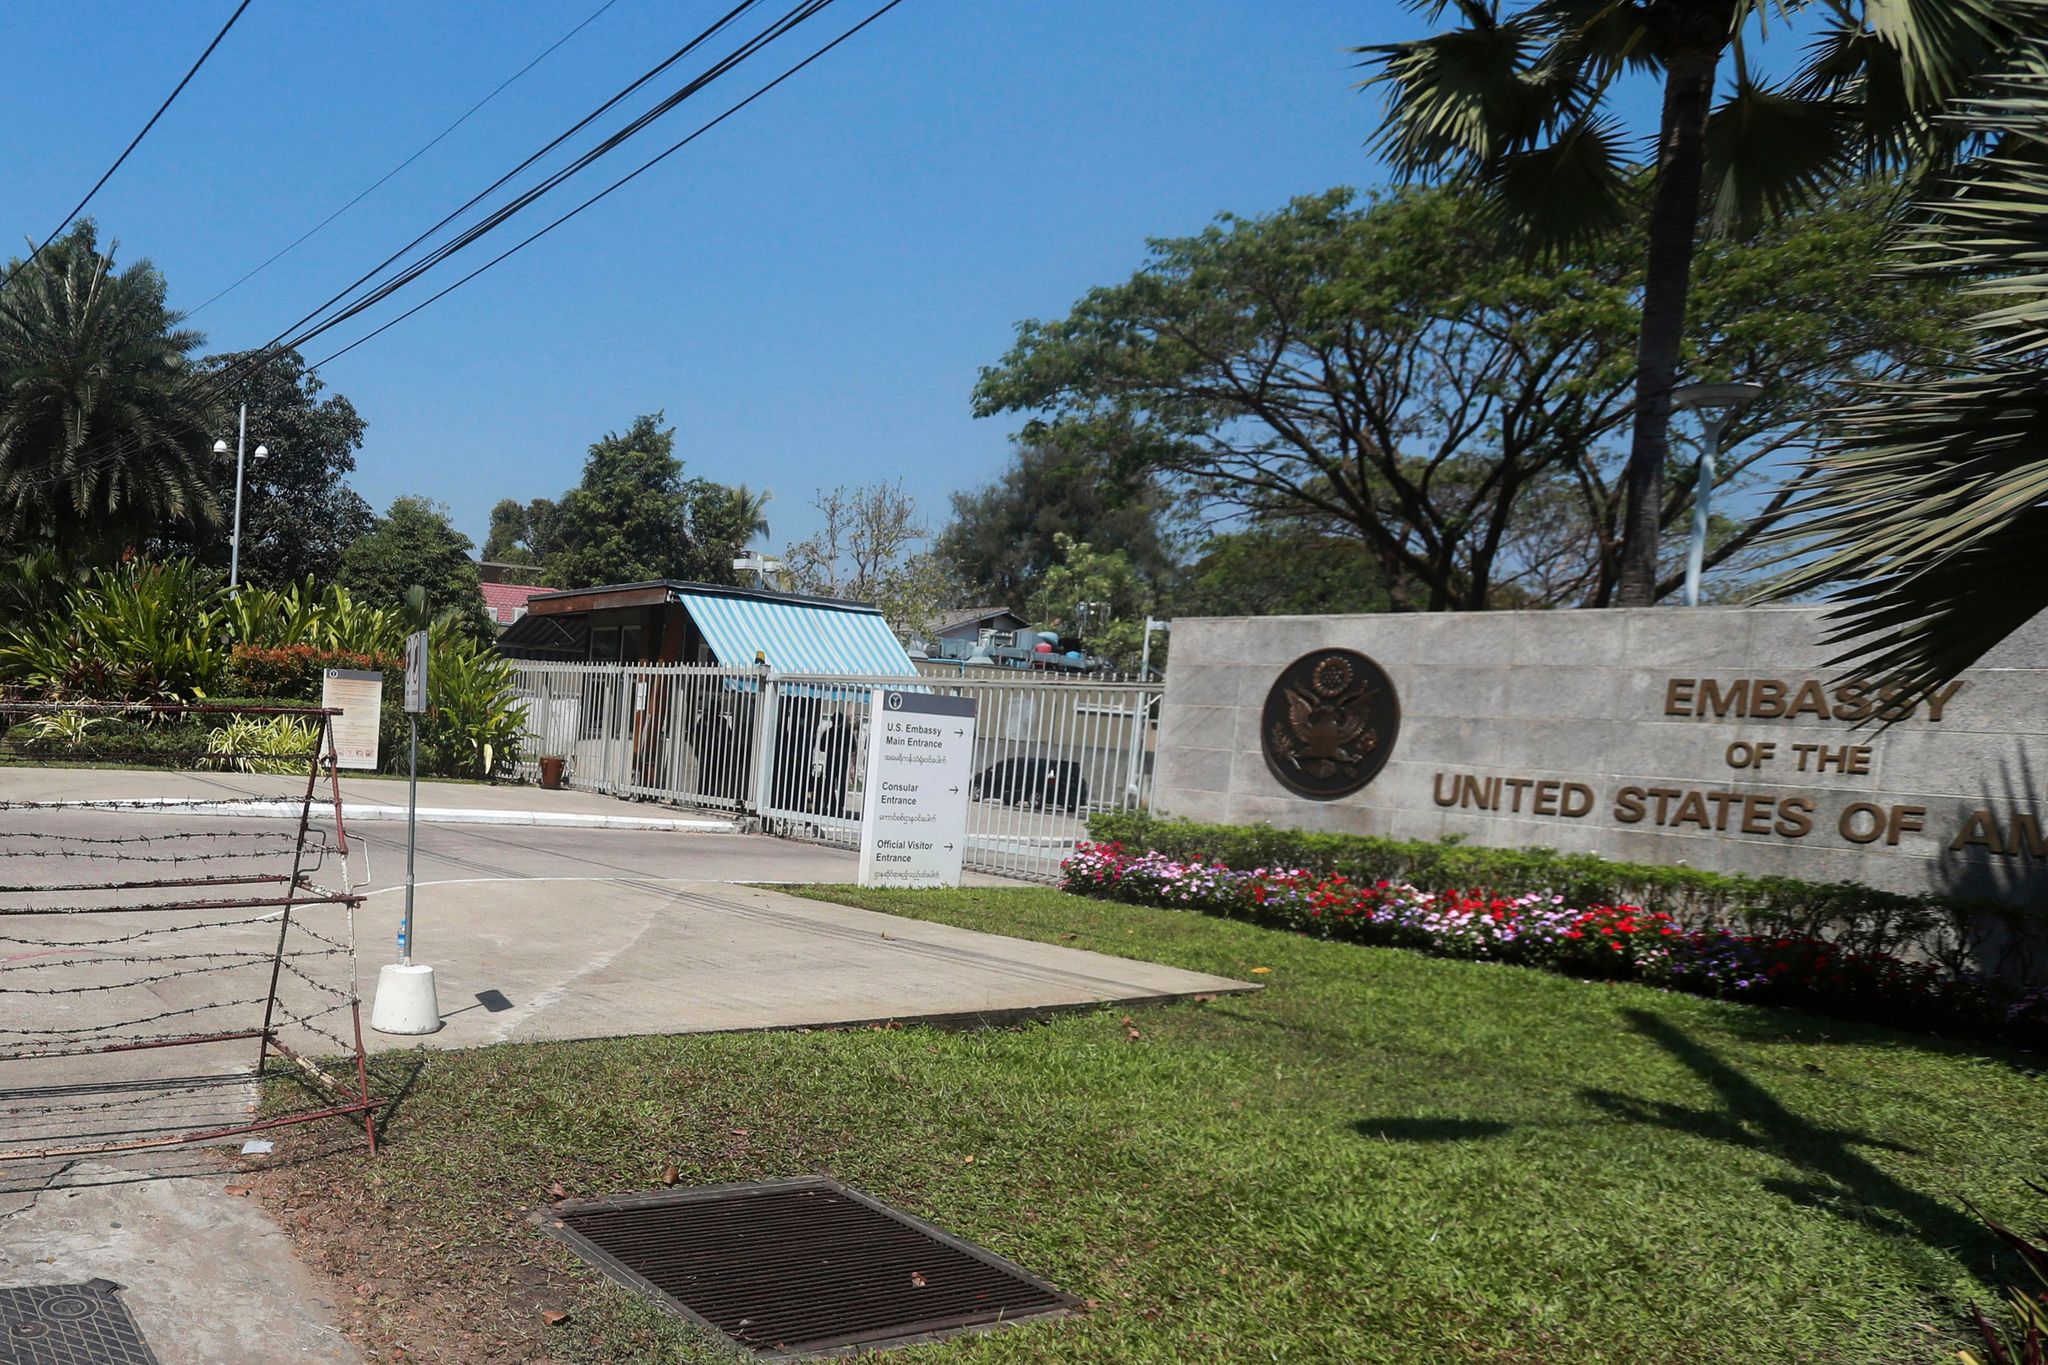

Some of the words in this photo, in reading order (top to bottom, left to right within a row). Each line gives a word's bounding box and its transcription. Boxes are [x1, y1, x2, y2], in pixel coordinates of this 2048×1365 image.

[887, 722, 904, 733] U.S.
[906, 723, 942, 737] Embassy
[886, 735, 905, 746] Main
[907, 737, 943, 748] Entrance
[1725, 741, 1777, 769] OF
[1791, 743, 1873, 775] THE
[882, 781, 919, 792] Consular
[881, 794, 917, 805] Entrance
[1433, 773, 1595, 818] UNITED
[1613, 786, 1817, 838] STATES
[1838, 802, 1927, 846] OF
[877, 839, 906, 849] Official
[907, 840, 933, 850] Visitor
[876, 852, 912, 862] Entrance
